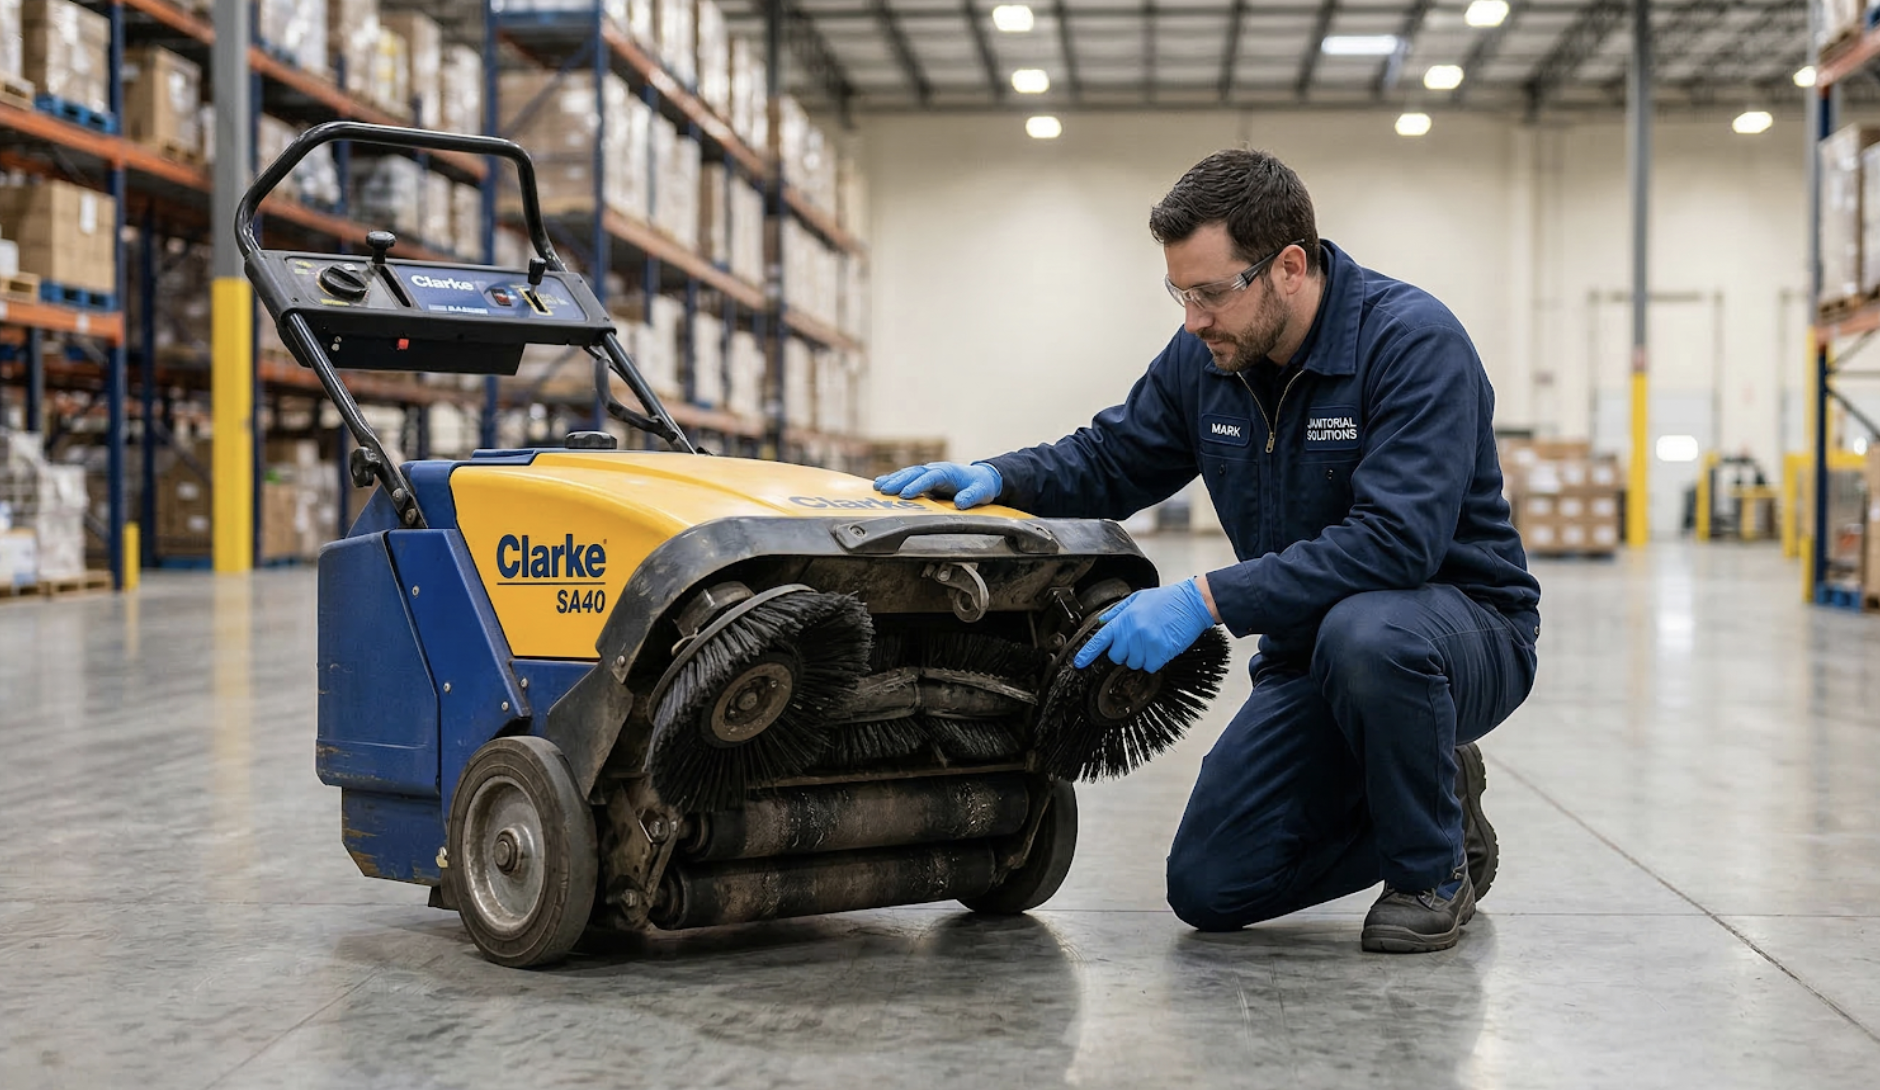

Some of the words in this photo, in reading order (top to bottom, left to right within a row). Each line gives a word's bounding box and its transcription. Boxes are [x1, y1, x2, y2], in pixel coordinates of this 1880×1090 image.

[411, 275, 474, 291] Clarke
[1211, 423, 1241, 438] MARK
[1307, 428, 1358, 441] SOLUTIONS
[788, 496, 927, 510] Clarke
[496, 533, 606, 579] Clarke
[556, 589, 606, 614] SA40
